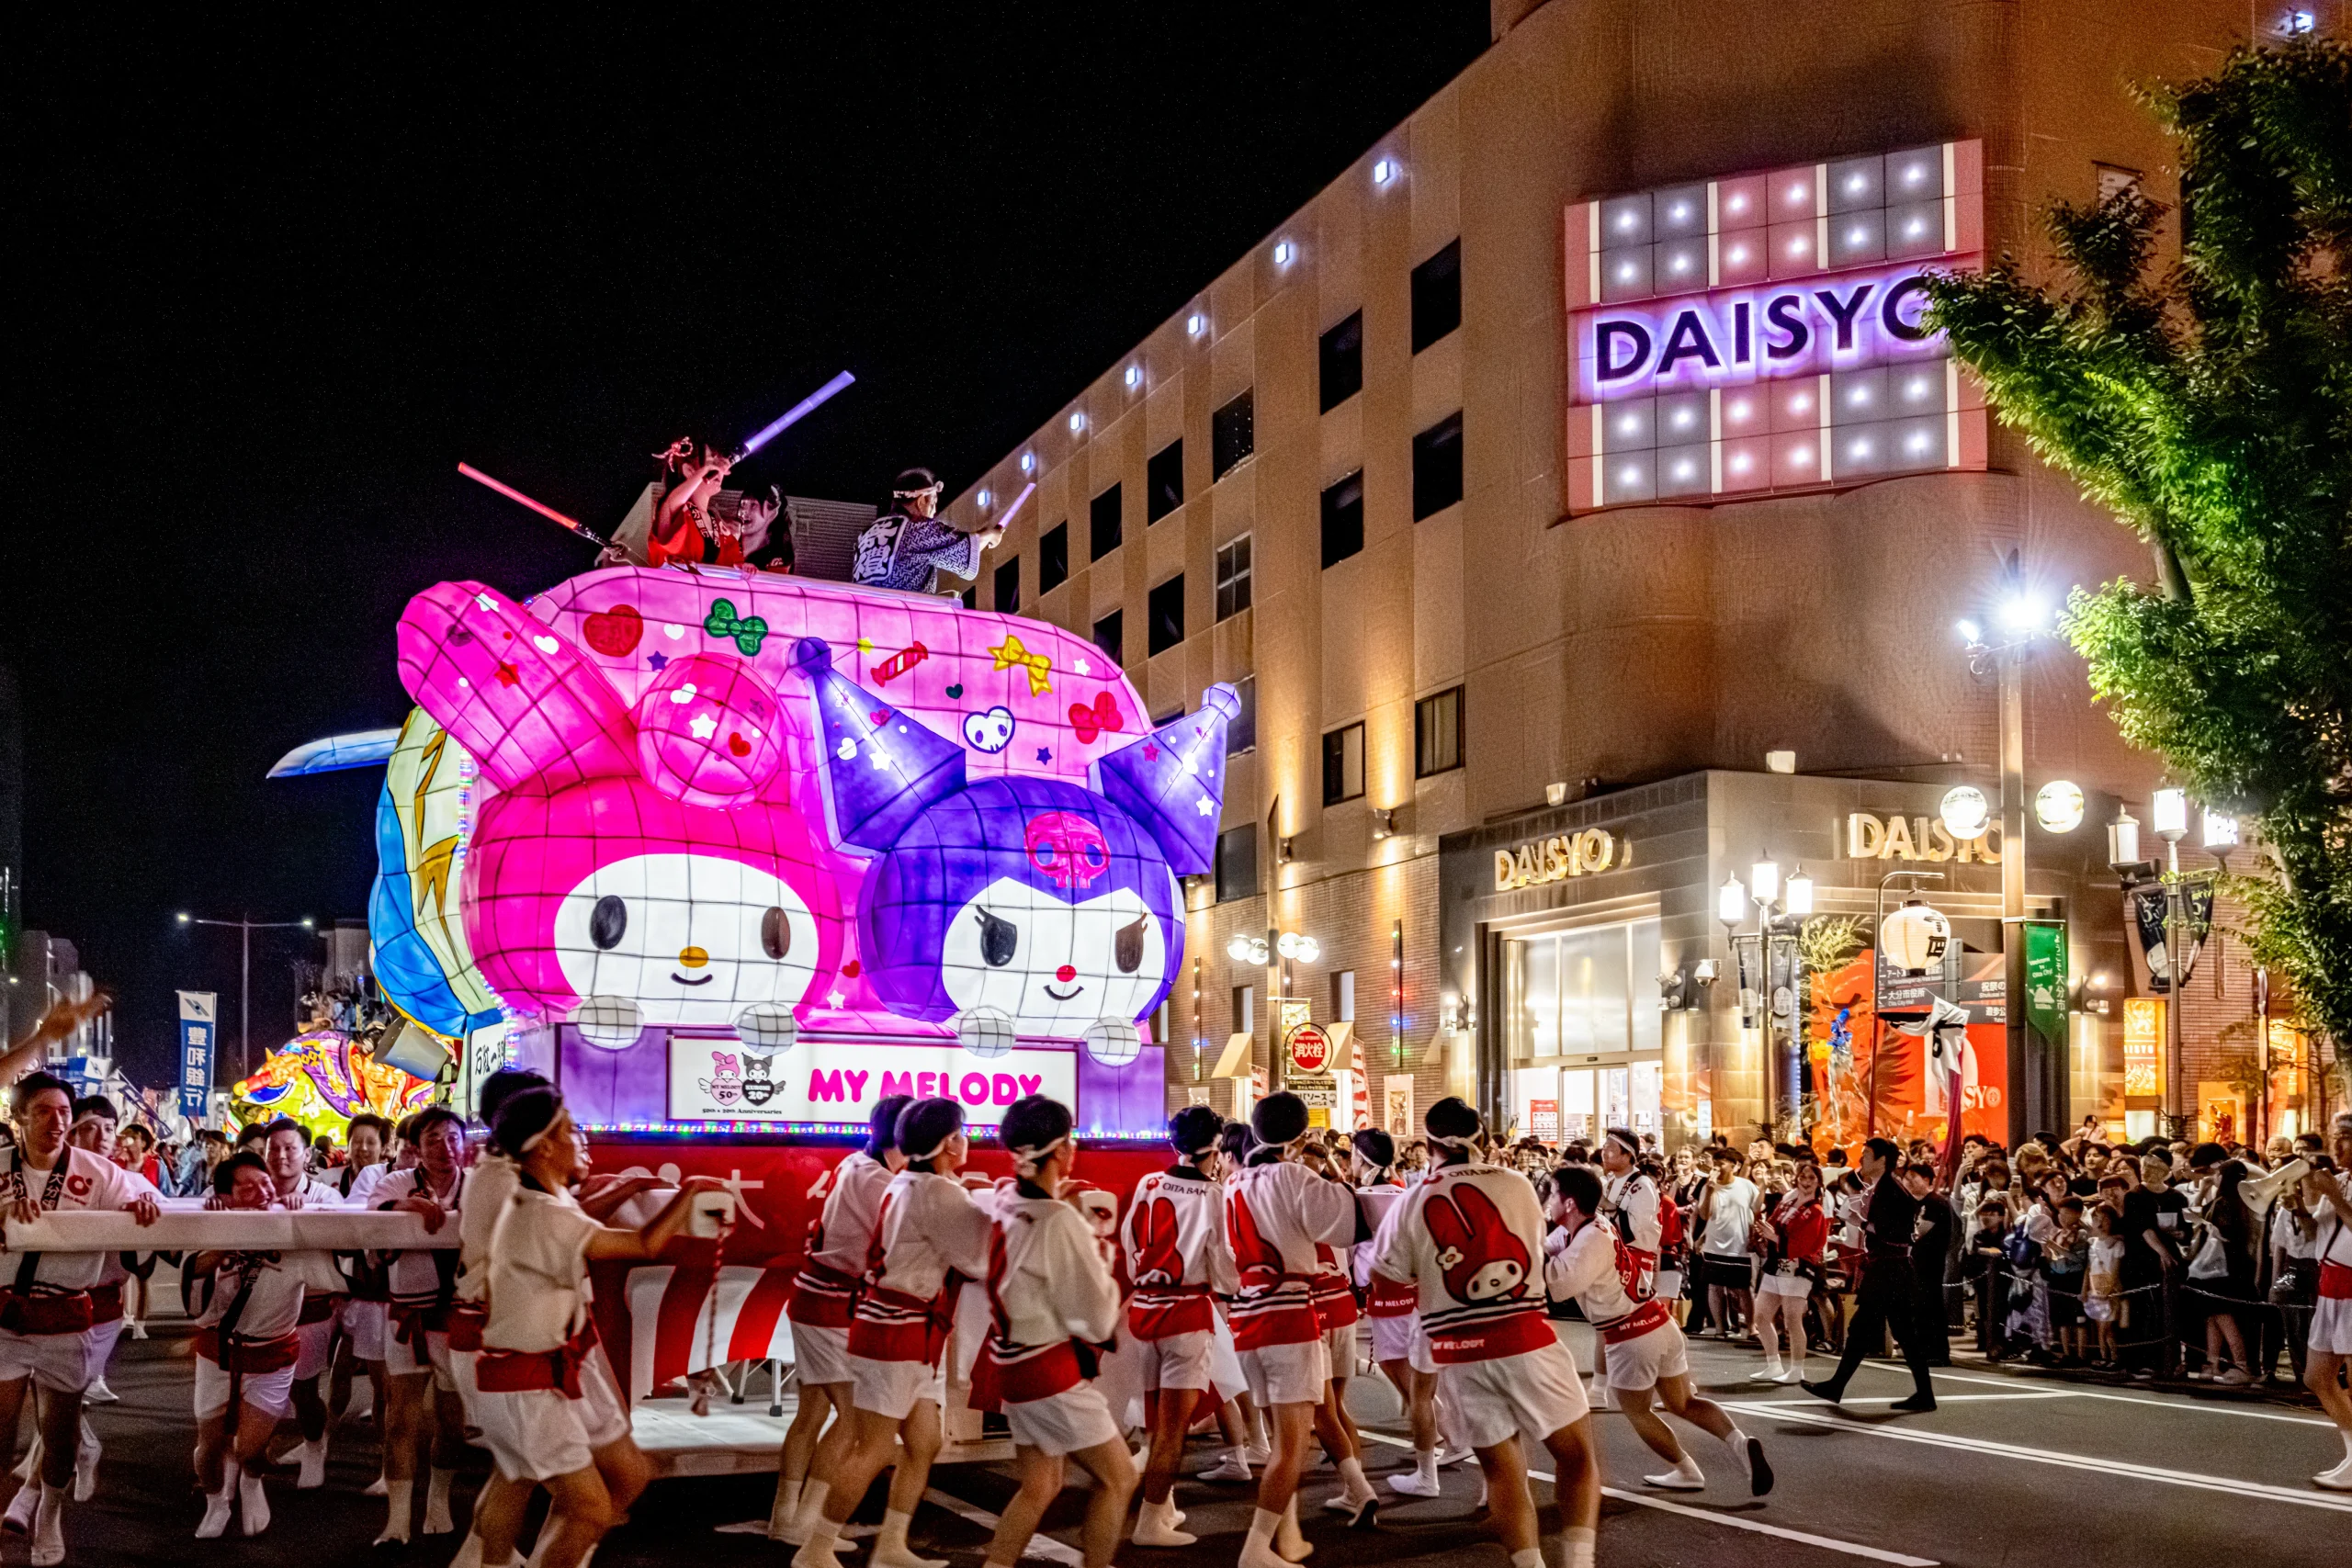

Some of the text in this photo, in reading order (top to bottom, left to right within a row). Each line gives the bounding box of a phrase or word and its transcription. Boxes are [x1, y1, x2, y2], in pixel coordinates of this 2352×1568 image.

[1495, 828, 1613, 891] DAISYO
[1295, 1043, 1323, 1057] 消火栓
[808, 1068, 1042, 1105] MY MELODY
[1162, 1182, 1185, 1194] OITA
